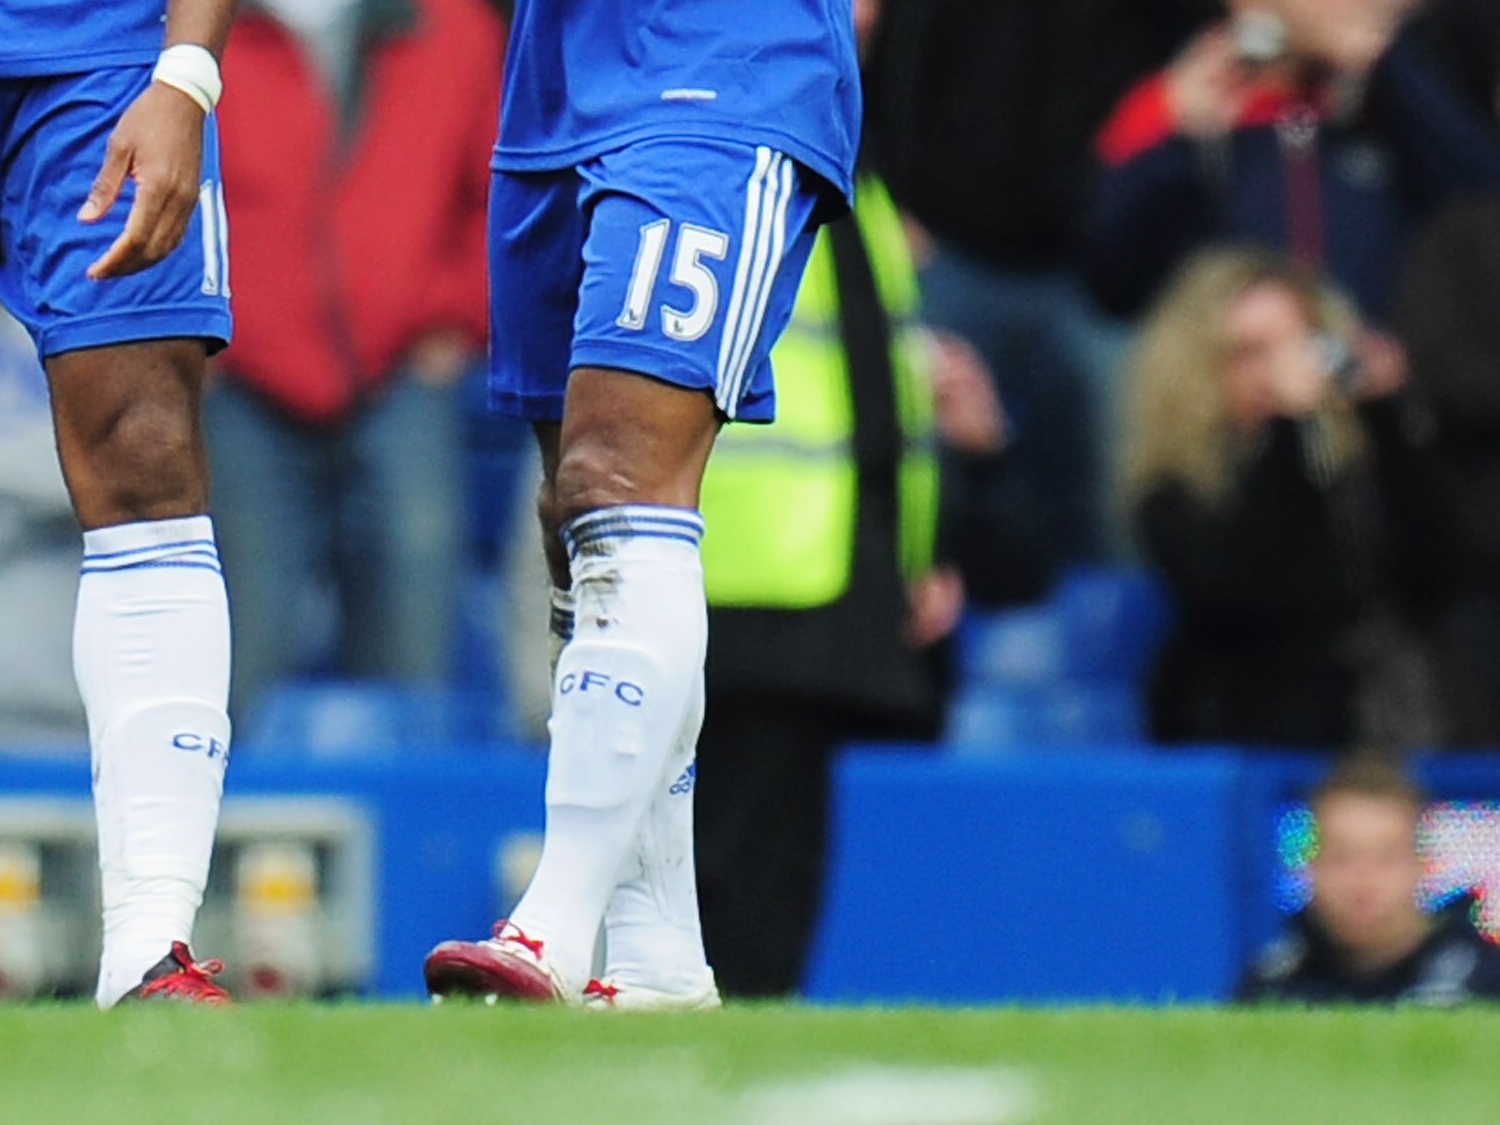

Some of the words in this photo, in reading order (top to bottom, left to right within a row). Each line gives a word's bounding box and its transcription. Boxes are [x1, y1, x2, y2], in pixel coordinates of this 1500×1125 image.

[616, 218, 730, 342] 15
[560, 671, 645, 707] CFC
[172, 731, 229, 759] CF
